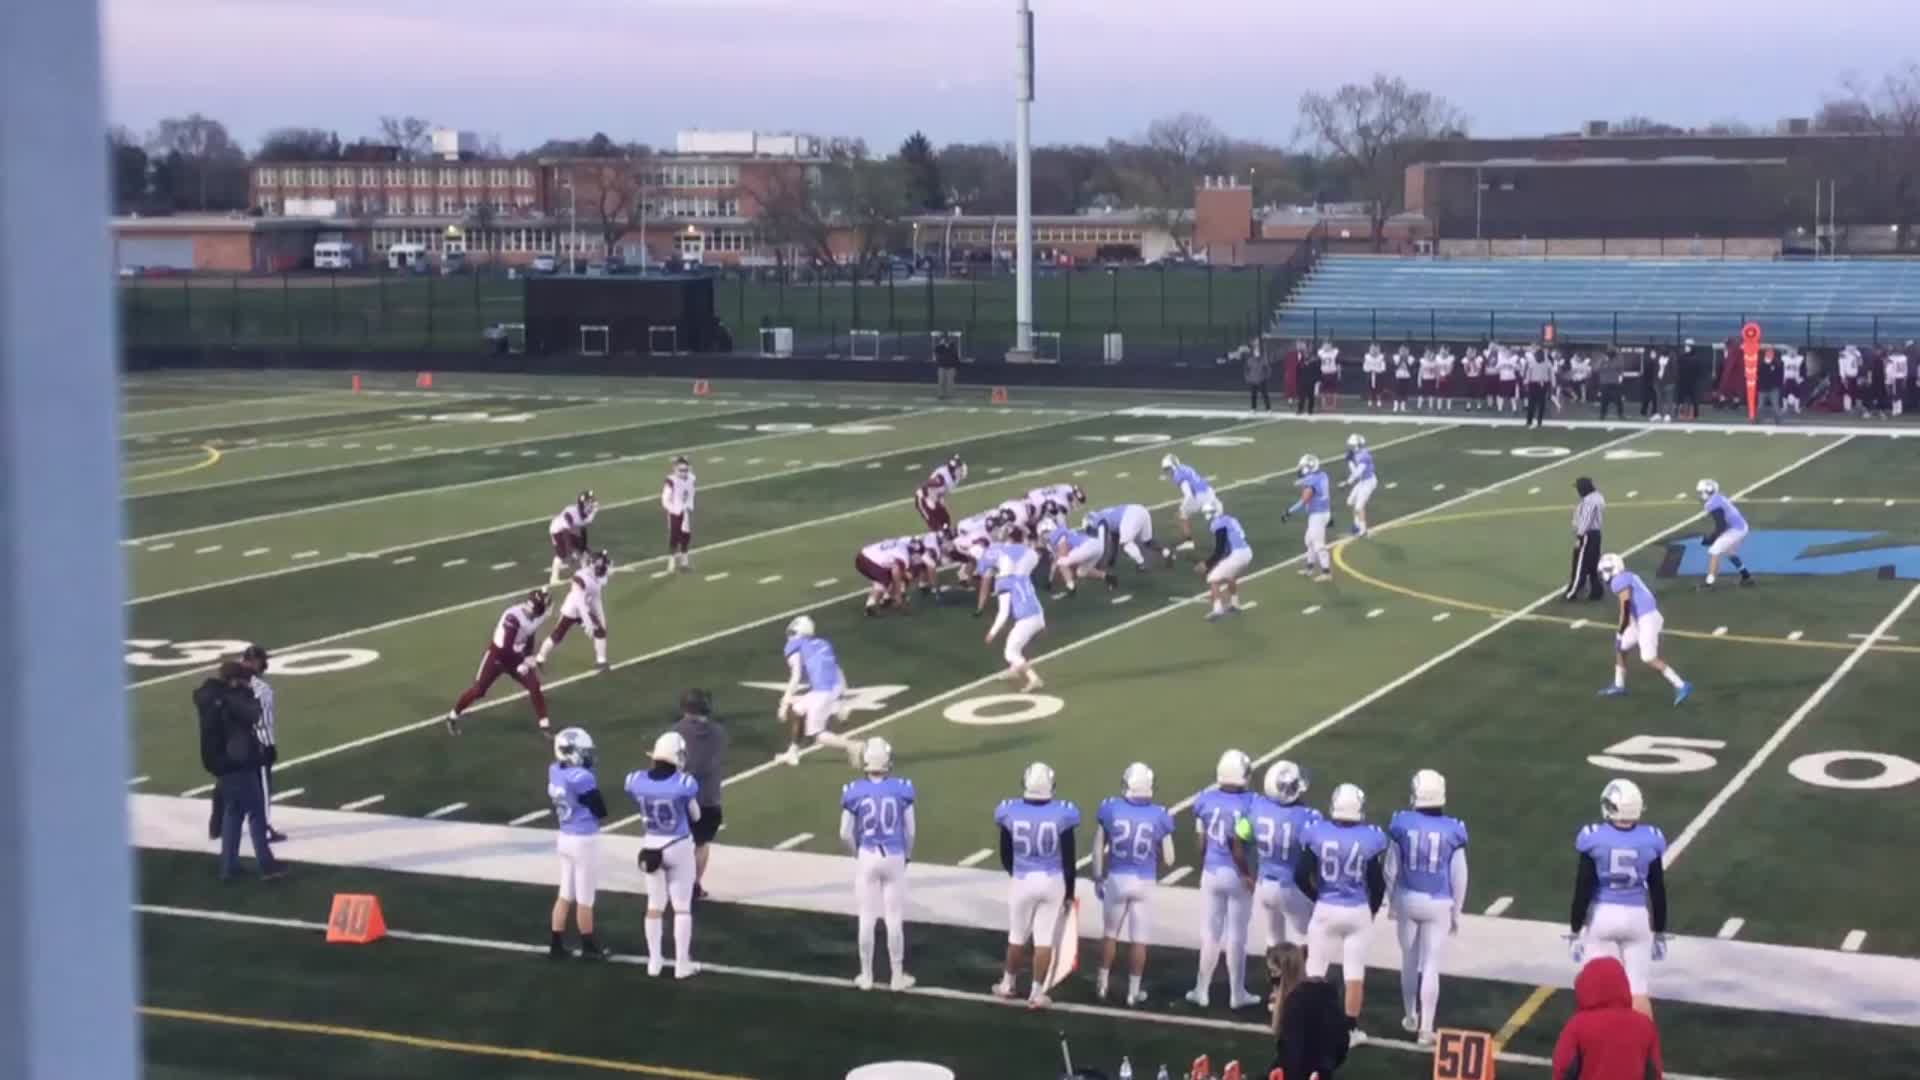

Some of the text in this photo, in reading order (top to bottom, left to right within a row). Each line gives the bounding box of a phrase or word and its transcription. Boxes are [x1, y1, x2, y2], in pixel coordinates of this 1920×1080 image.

[860, 797, 897, 834] 20
[1012, 819, 1058, 858] 50
[1112, 819, 1154, 862] 26
[1407, 829, 1441, 873] 11
[1321, 840, 1364, 882] 64
[1610, 848, 1639, 889] 5
[1438, 1033, 1485, 1079] 50
